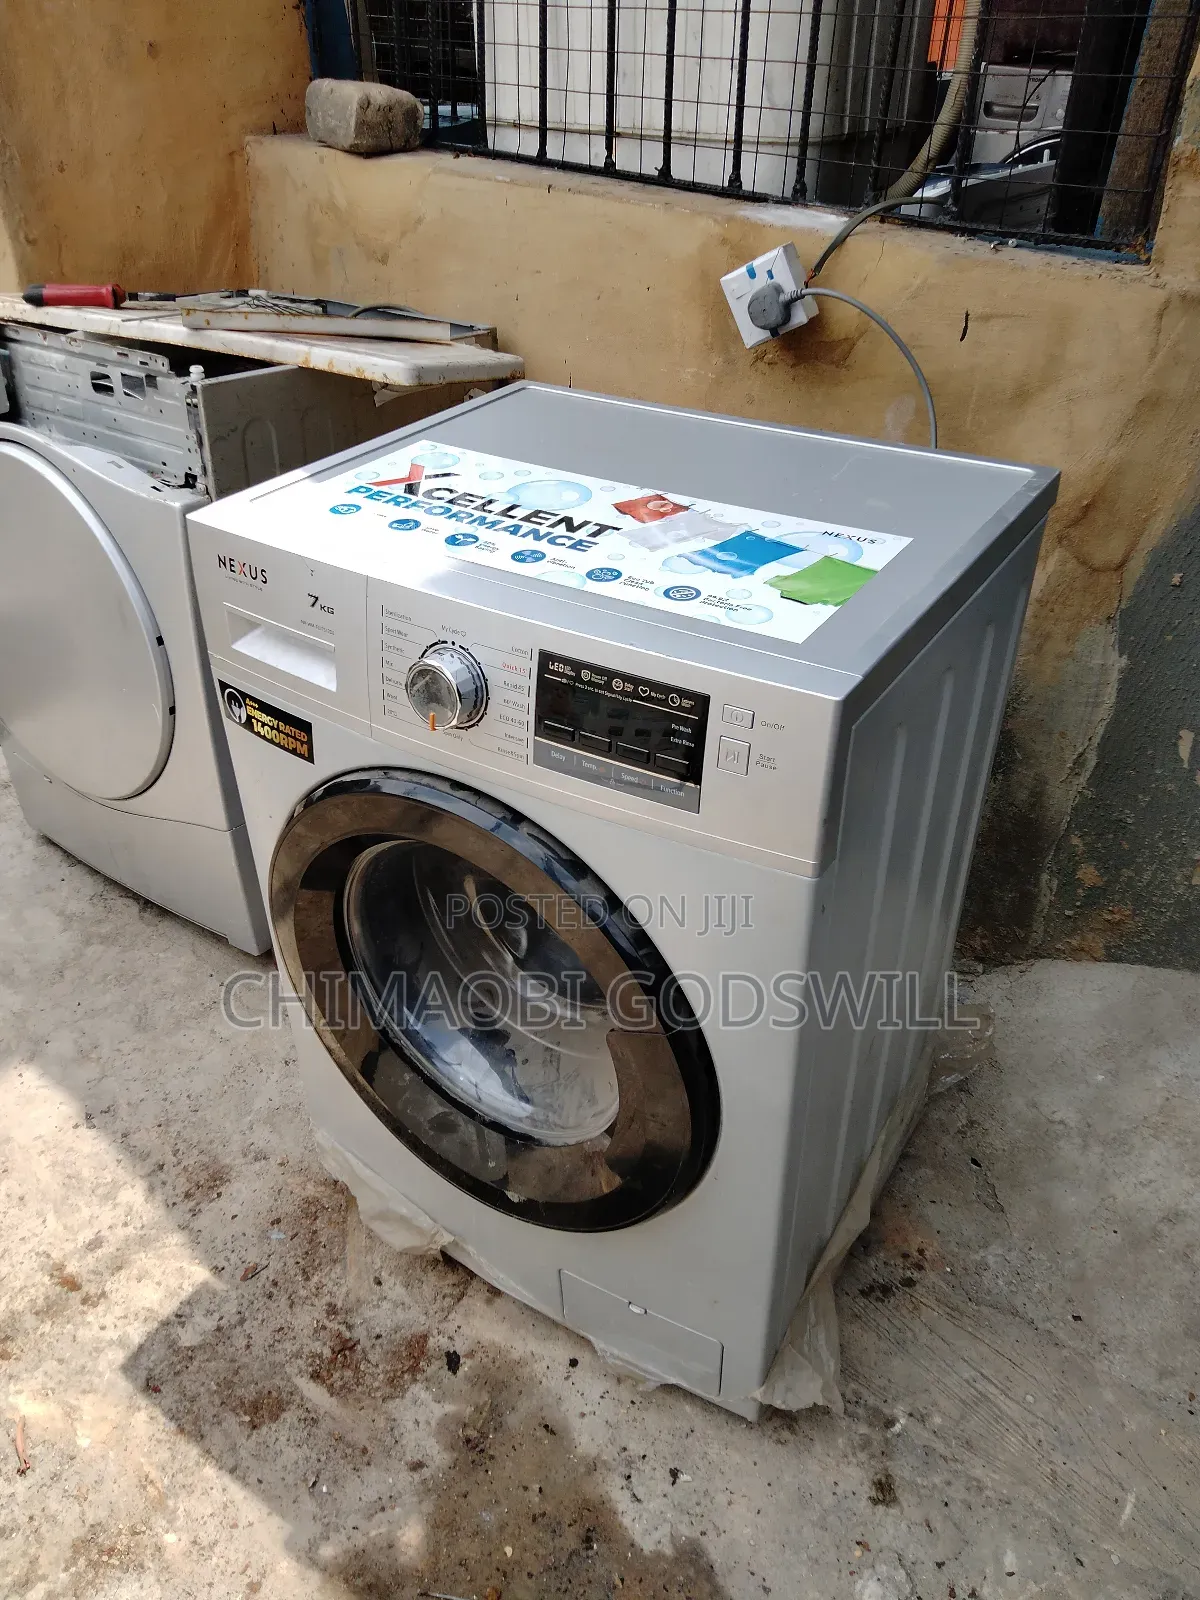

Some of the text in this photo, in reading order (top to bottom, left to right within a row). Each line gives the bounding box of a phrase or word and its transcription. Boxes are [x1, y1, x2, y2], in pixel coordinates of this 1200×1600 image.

[365, 462, 624, 539] XCELLENT
[344, 484, 600, 553] PERFORMANCE
[821, 530, 878, 545] NEXUS
[217, 553, 268, 585] NEXUS
[502, 661, 518, 672] Quick
[548, 661, 564, 673] LED
[246, 705, 308, 742] ENERGY RATED
[760, 720, 785, 731] On/Off
[251, 718, 309, 758] 1400RPM
[551, 750, 566, 762] Delay
[582, 760, 598, 771] Temp.
[620, 772, 639, 784] Speed
[660, 784, 685, 798] Function
